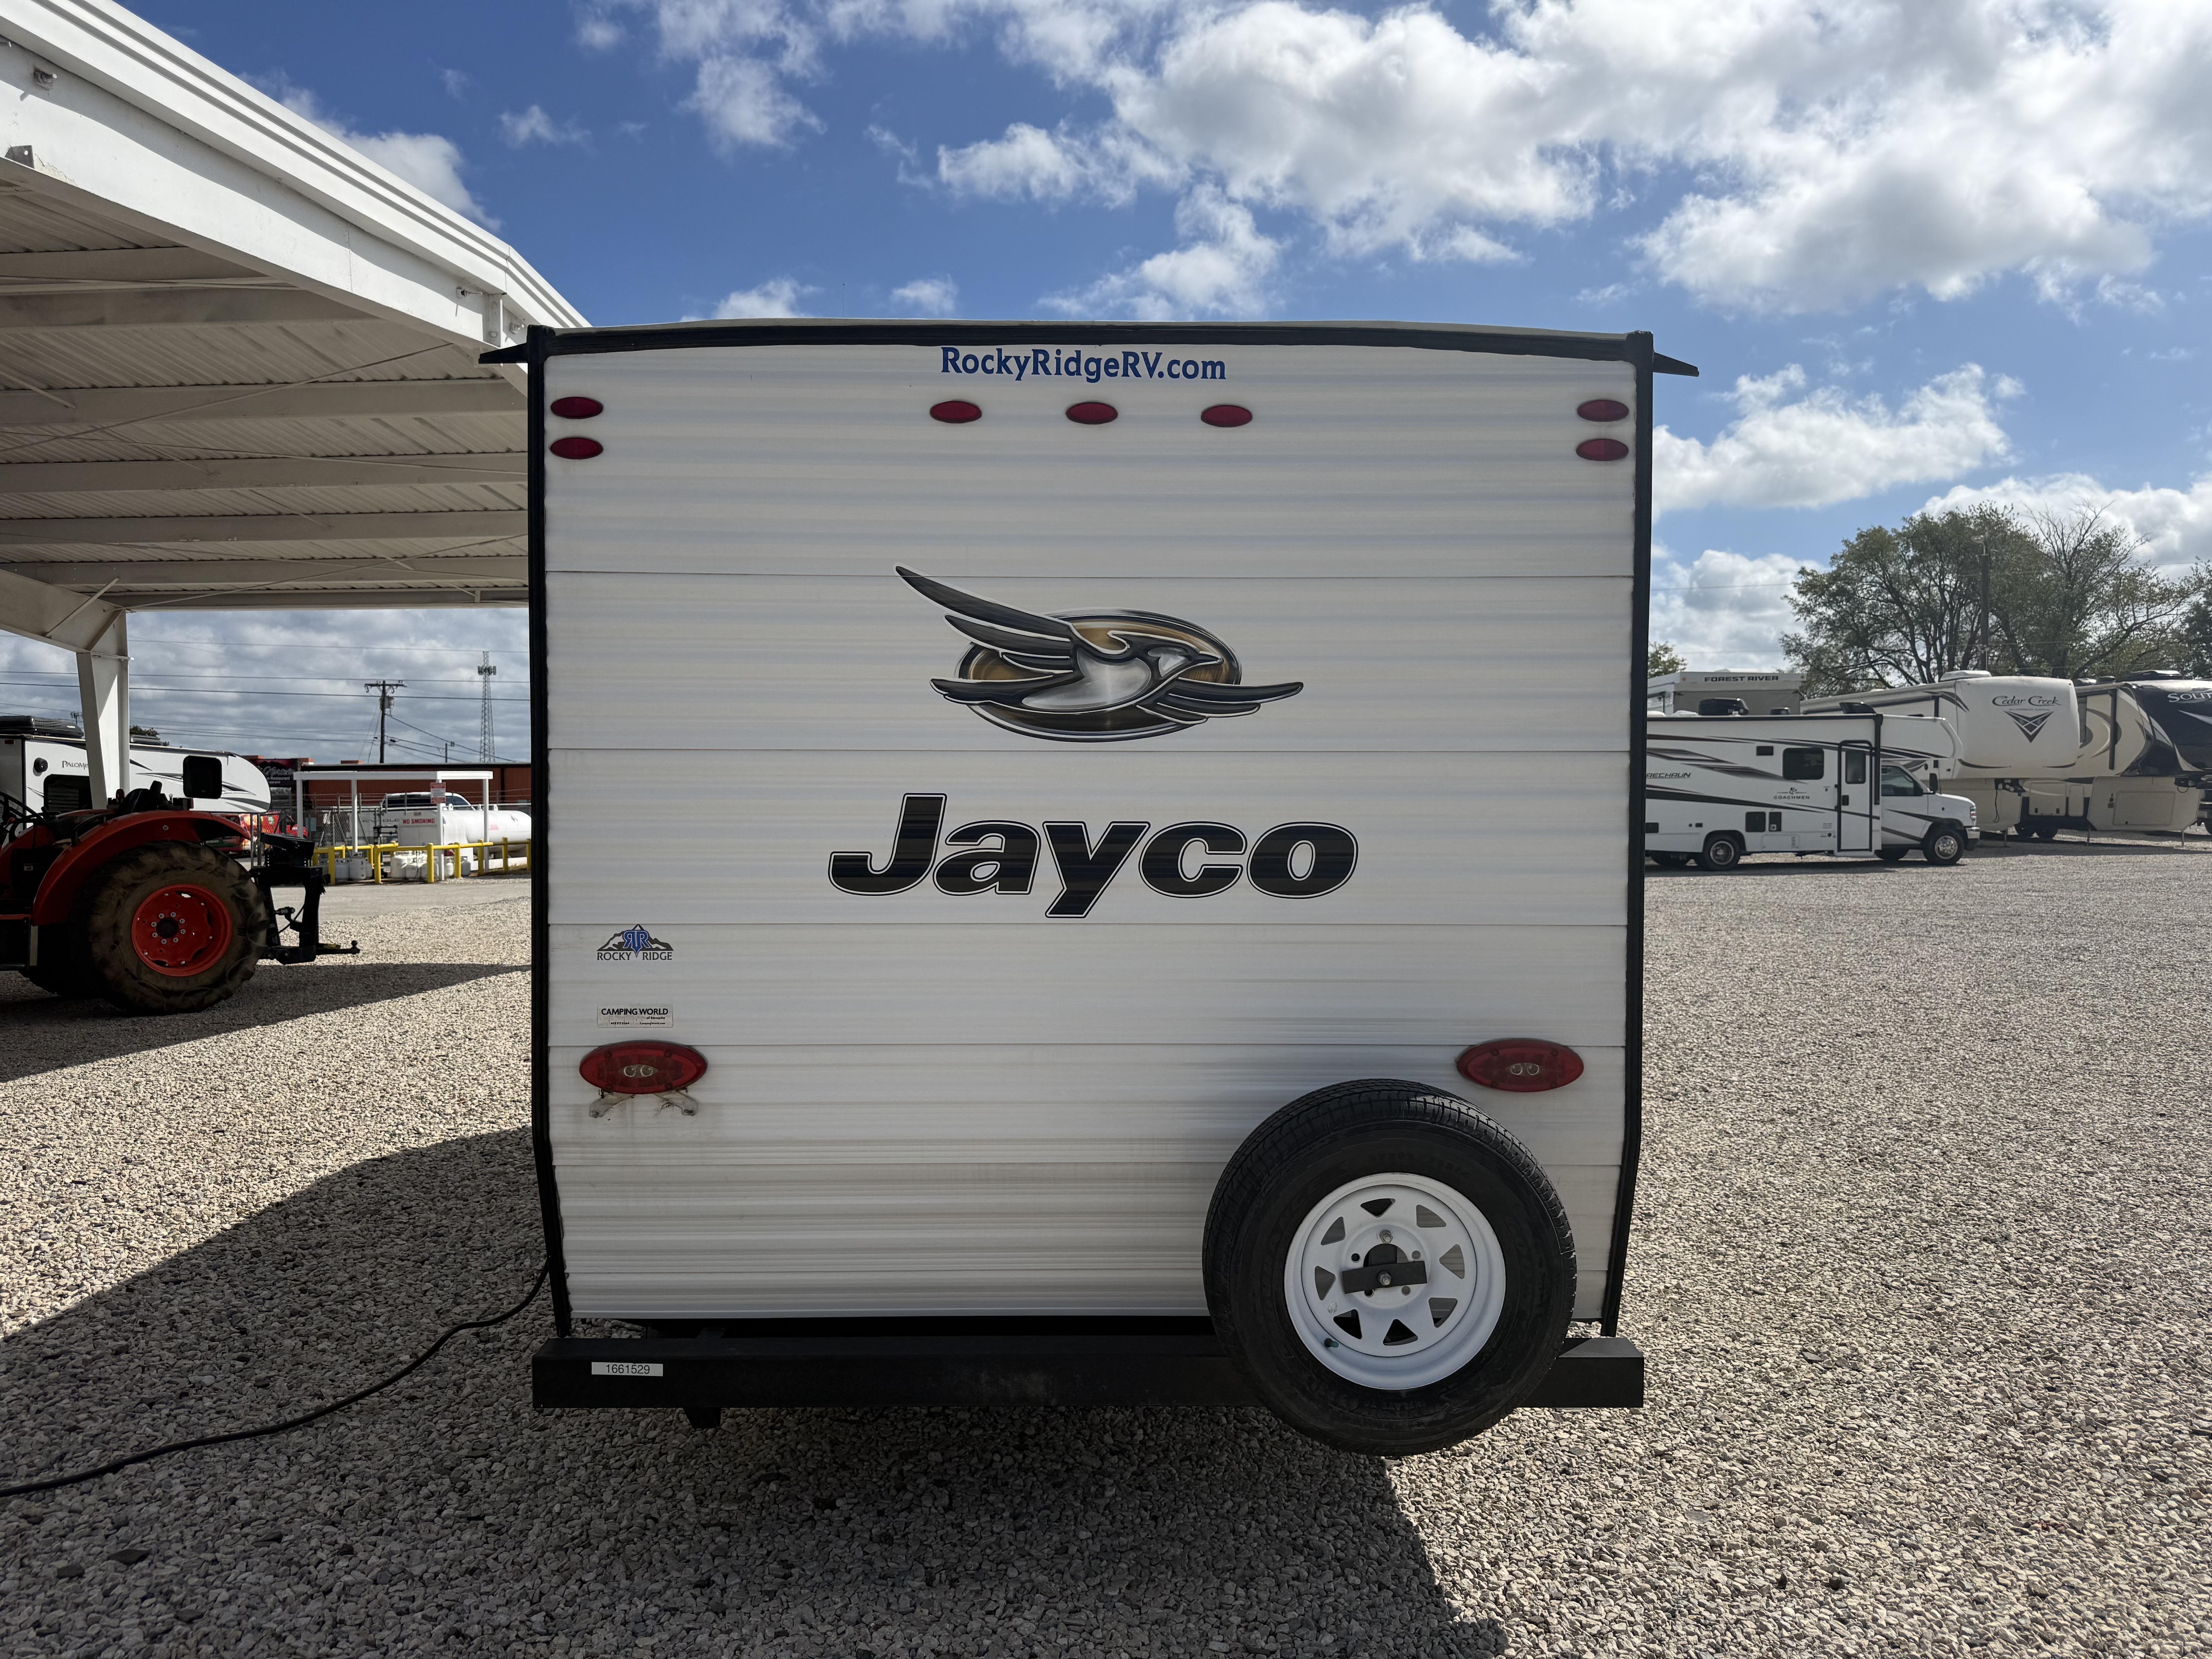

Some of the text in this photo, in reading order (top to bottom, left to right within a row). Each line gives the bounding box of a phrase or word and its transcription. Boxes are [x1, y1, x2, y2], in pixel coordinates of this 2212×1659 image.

[941, 347, 1226, 383] RockyRidgeRV.com
[1992, 696, 2062, 706] Cedar Creek
[828, 793, 1358, 919] Jayco
[597, 952, 672, 960] ROCKY RIDGE
[606, 1364, 650, 1374] 1661529
